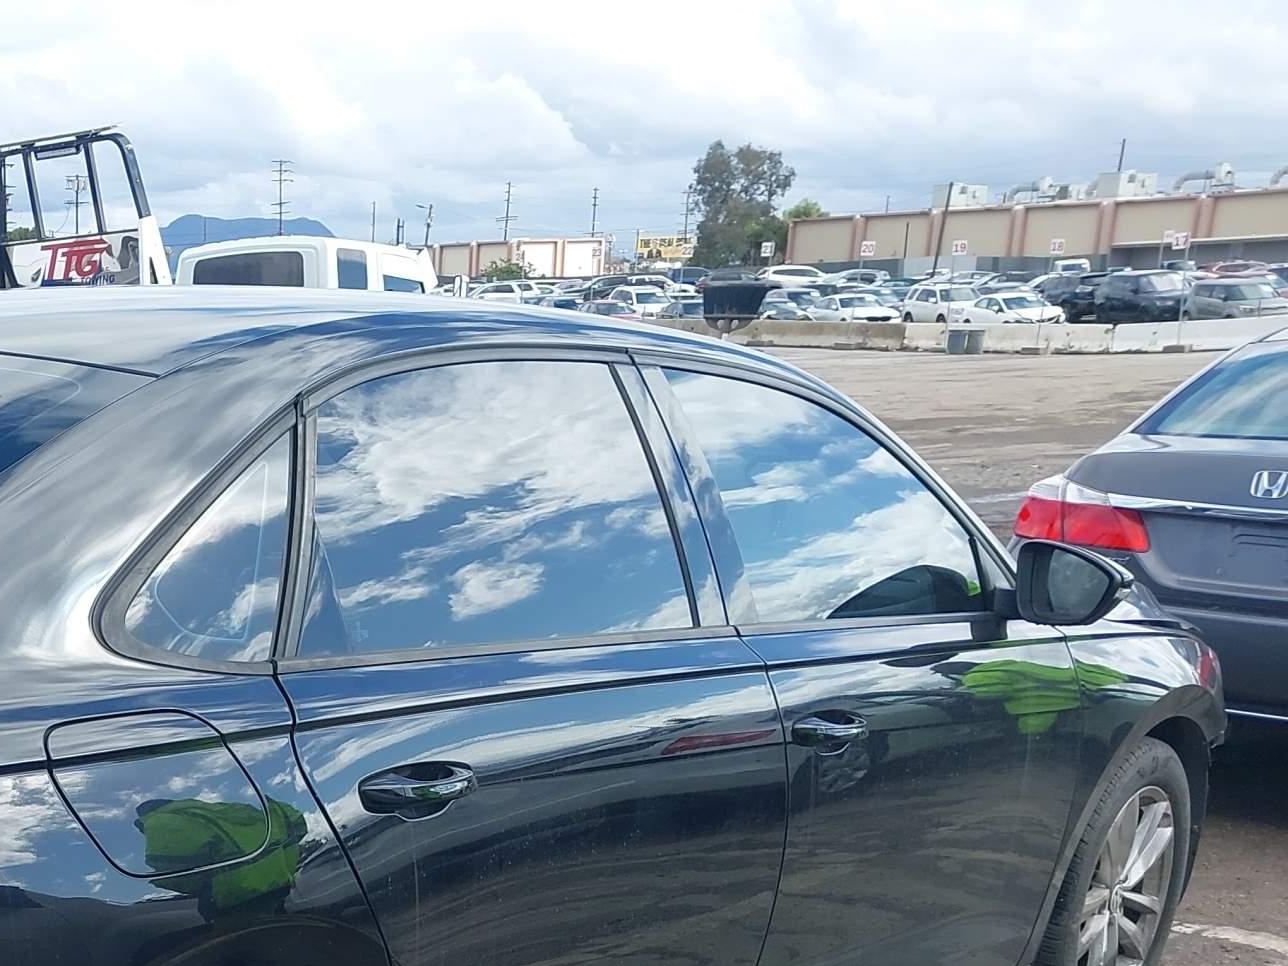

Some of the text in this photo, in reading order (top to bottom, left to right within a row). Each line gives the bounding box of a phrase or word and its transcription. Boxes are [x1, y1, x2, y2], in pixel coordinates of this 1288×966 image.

[1174, 233, 1189, 248] 17
[680, 246, 693, 255] 22
[862, 243, 873, 254] 20
